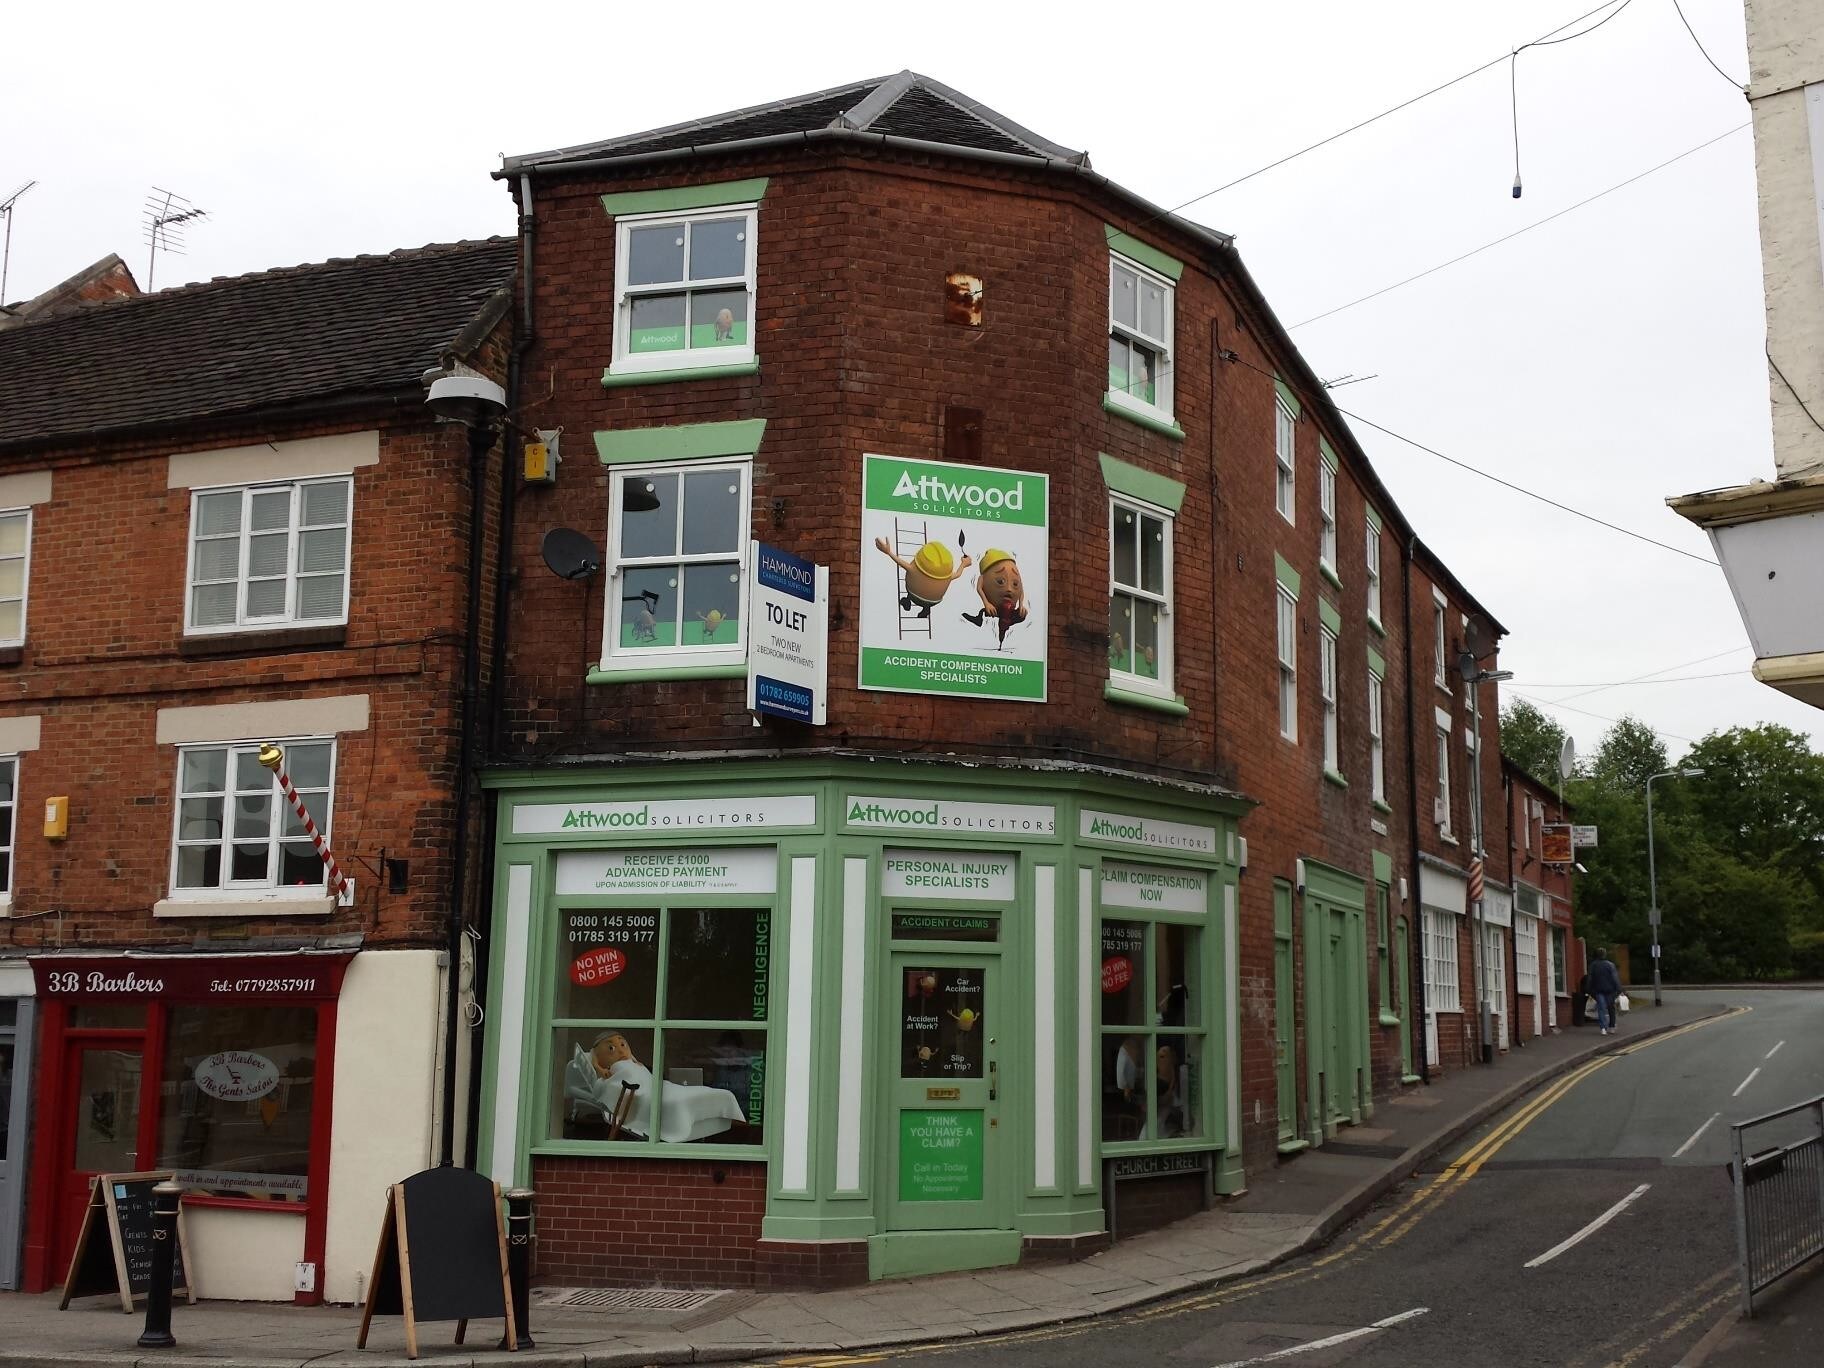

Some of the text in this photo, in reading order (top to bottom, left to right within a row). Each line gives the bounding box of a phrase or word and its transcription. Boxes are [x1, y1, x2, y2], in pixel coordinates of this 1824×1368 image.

[641, 334, 677, 344] Attwood
[892, 470, 1023, 510] Attwood
[914, 503, 1001, 519] SOLICITORS
[762, 555, 811, 585] HAMMOND
[766, 602, 807, 633] TO LET
[771, 636, 802, 653] TWO NEW
[761, 645, 784, 660] BEDROOM
[884, 656, 1023, 675] ACCIDENT COMPENSATION
[920, 671, 987, 684] SPECIALISTS
[760, 684, 810, 706] 01782 659905
[561, 805, 765, 828] Attwood SOLICITORS
[848, 801, 1054, 831] Attwood SOLICITORS
[1090, 817, 1208, 849] Attwood SOLICITORS
[624, 855, 710, 866] RECEIVE £1000
[887, 860, 1008, 875] PERSONAL INJURY
[605, 866, 728, 878] ADVANCED PAYMENT
[617, 880, 657, 888] ADMISSION
[659, 880, 670, 888] OF
[672, 880, 706, 888] LIABILITY
[905, 875, 989, 888] SPECIALISTS
[1130, 872, 1202, 890] COMPENSATION
[1140, 889, 1163, 901] NOW
[569, 915, 655, 927] 0800 145 5006
[901, 917, 989, 928] ACCIDENT CLAIMS
[569, 931, 655, 942] 01785 319 177
[1102, 928, 1111, 937] 00
[1113, 928, 1125, 938] 145
[1102, 940, 1143, 951] 785 319 177
[576, 950, 618, 971] NO WIN
[753, 912, 769, 1018] NEGLIGENCE
[1101, 959, 1128, 977] NO WIN
[578, 962, 620, 982] NO FEE
[49, 972, 164, 992] 3B Barbers
[210, 978, 316, 992] Tel: 07792857911
[1102, 972, 1129, 989] NO FEE
[906, 1015, 939, 1023] Accident
[208, 1052, 265, 1070] 3B Barbers
[951, 1054, 965, 1063] Slip
[954, 1063, 971, 1071] Trip?
[200, 1076, 272, 1098] The Gents Salon
[750, 1052, 764, 1126] MEDICAL
[926, 1116, 958, 1126] THINK
[910, 1127, 974, 1137] YOU HAVE A
[921, 1138, 961, 1148] CLAIM?
[1115, 1153, 1200, 1176] CHURCH STREET
[220, 1176, 266, 1189] appointments
[268, 1178, 304, 1189] available
